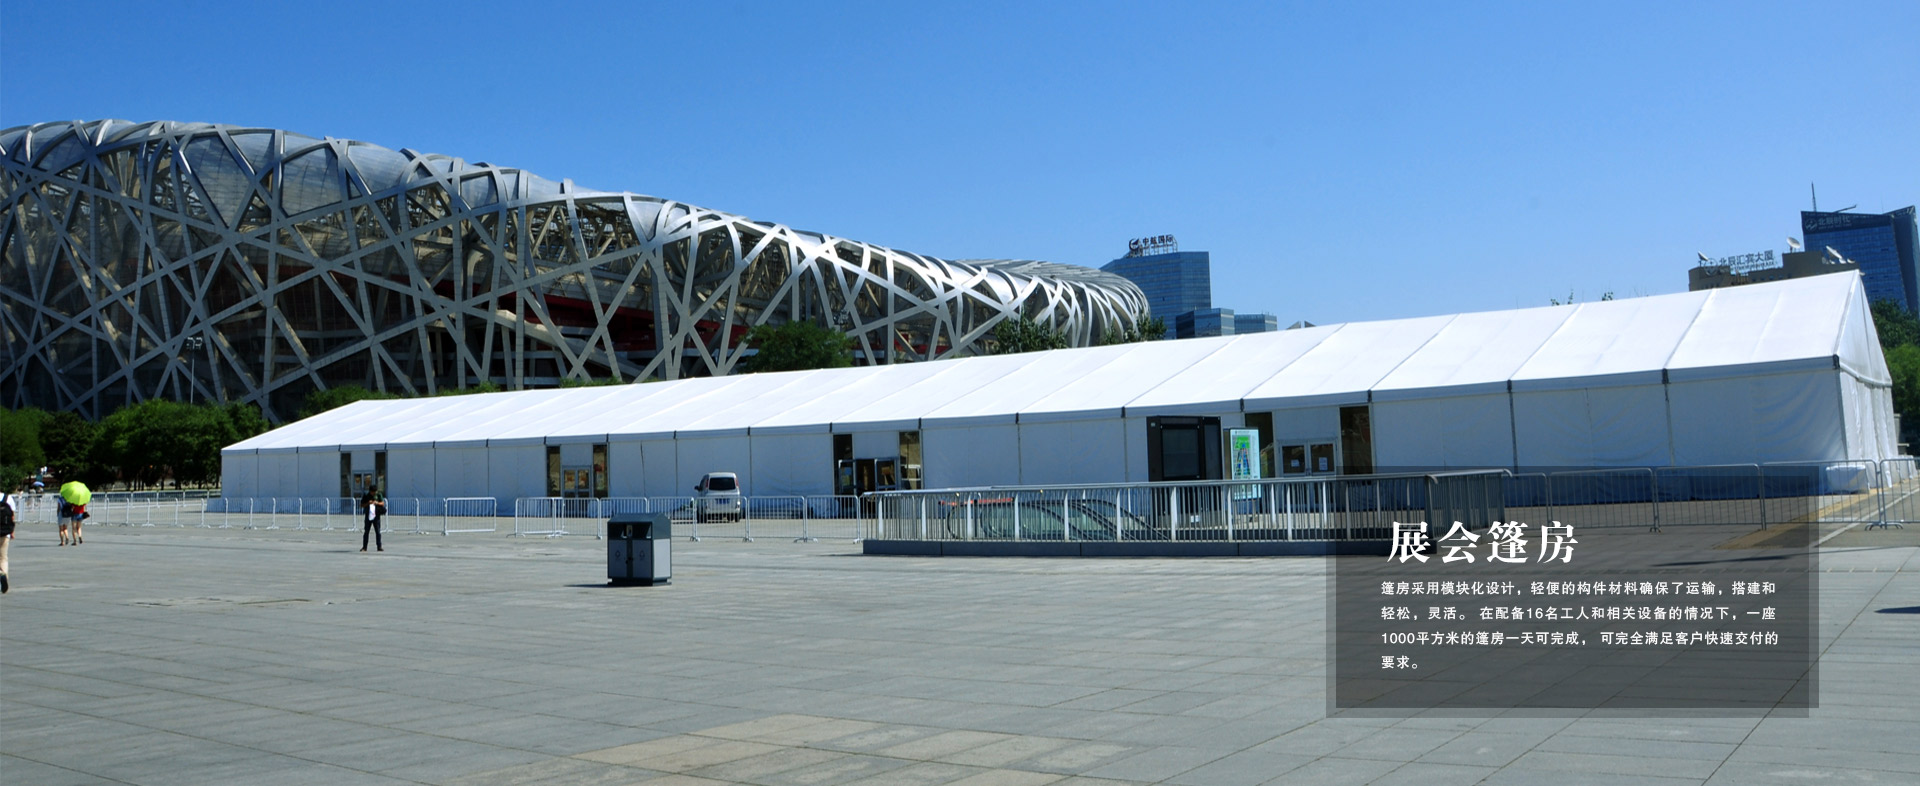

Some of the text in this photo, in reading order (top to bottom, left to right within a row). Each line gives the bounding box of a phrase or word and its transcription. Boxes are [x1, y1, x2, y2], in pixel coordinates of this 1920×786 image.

[1719, 250, 1774, 266] 北辰汇宾大厦
